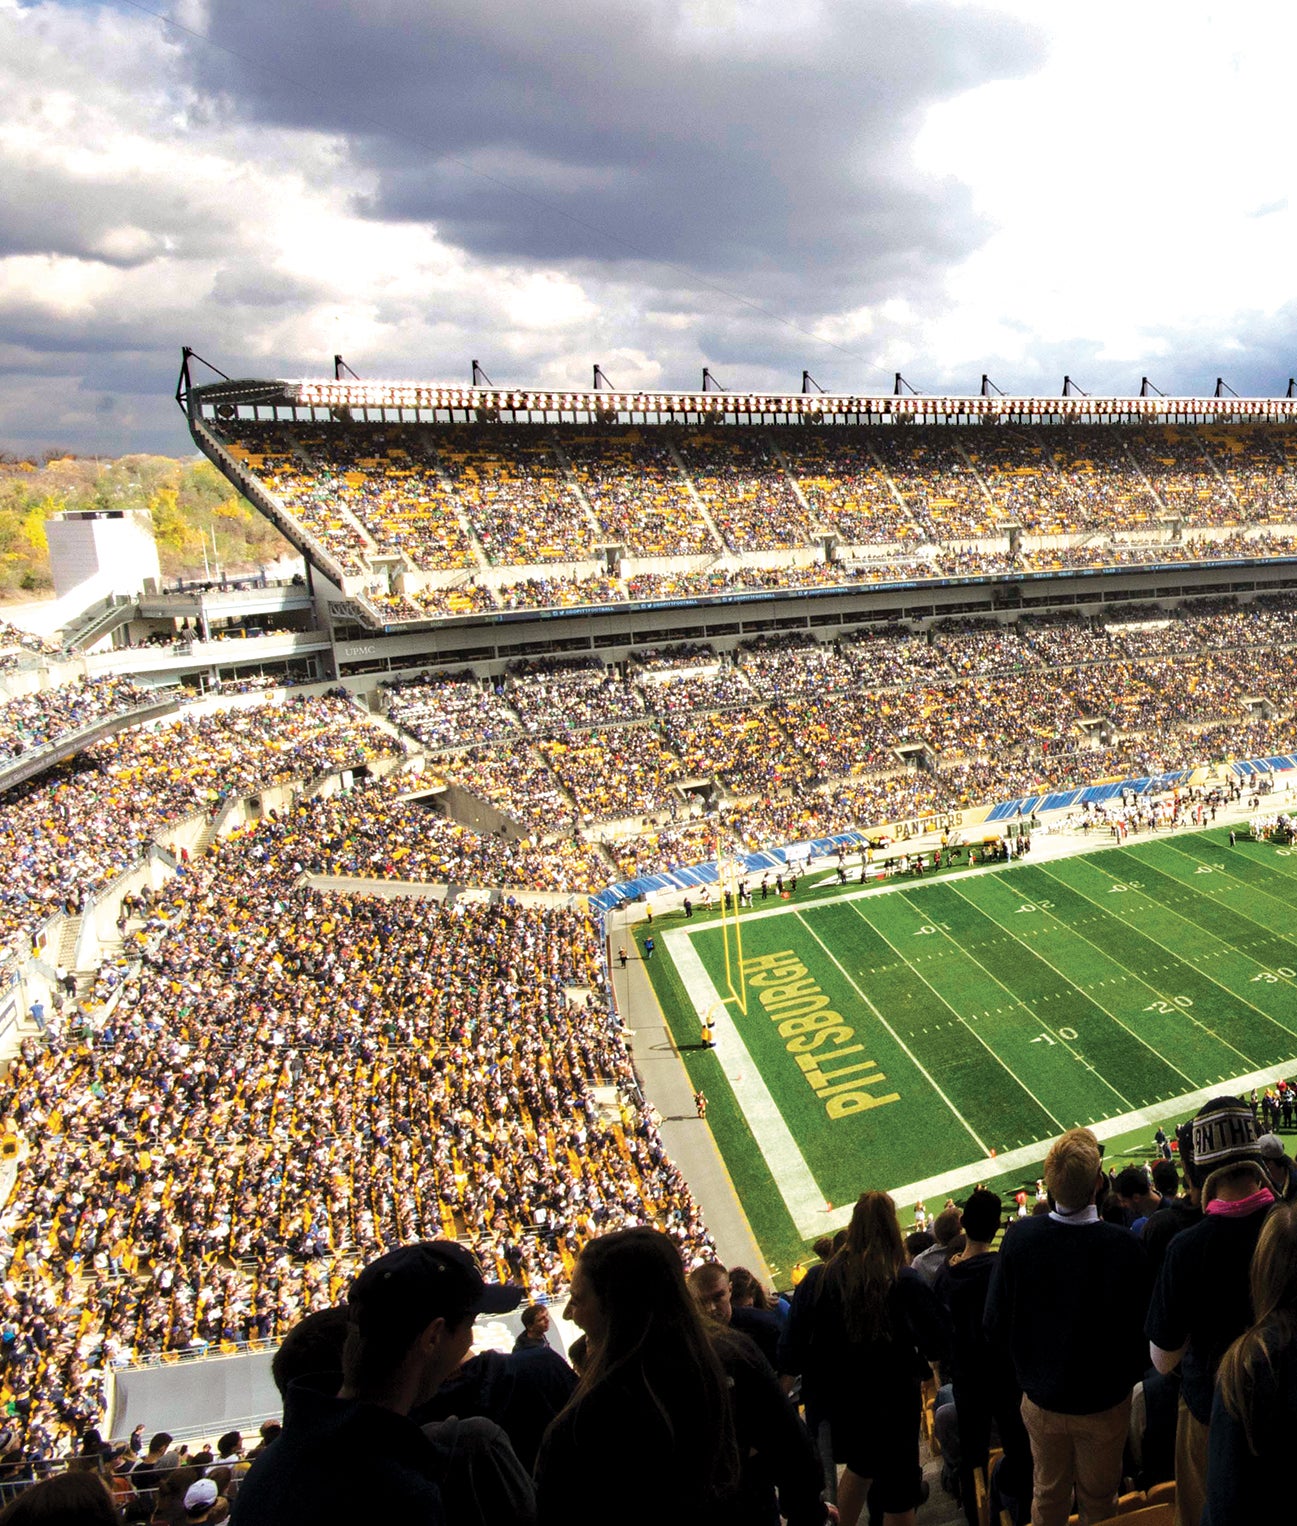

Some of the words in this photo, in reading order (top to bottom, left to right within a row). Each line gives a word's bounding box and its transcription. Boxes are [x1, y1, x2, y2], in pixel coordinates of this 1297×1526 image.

[344, 645, 376, 657] UPMC
[894, 812, 964, 839] PANTHERS
[1020, 899, 1056, 913] 20
[1256, 967, 1297, 984] 30
[1151, 995, 1194, 1015] 20
[737, 949, 902, 1121] PITTSBURGH
[1039, 1026, 1079, 1046] 10
